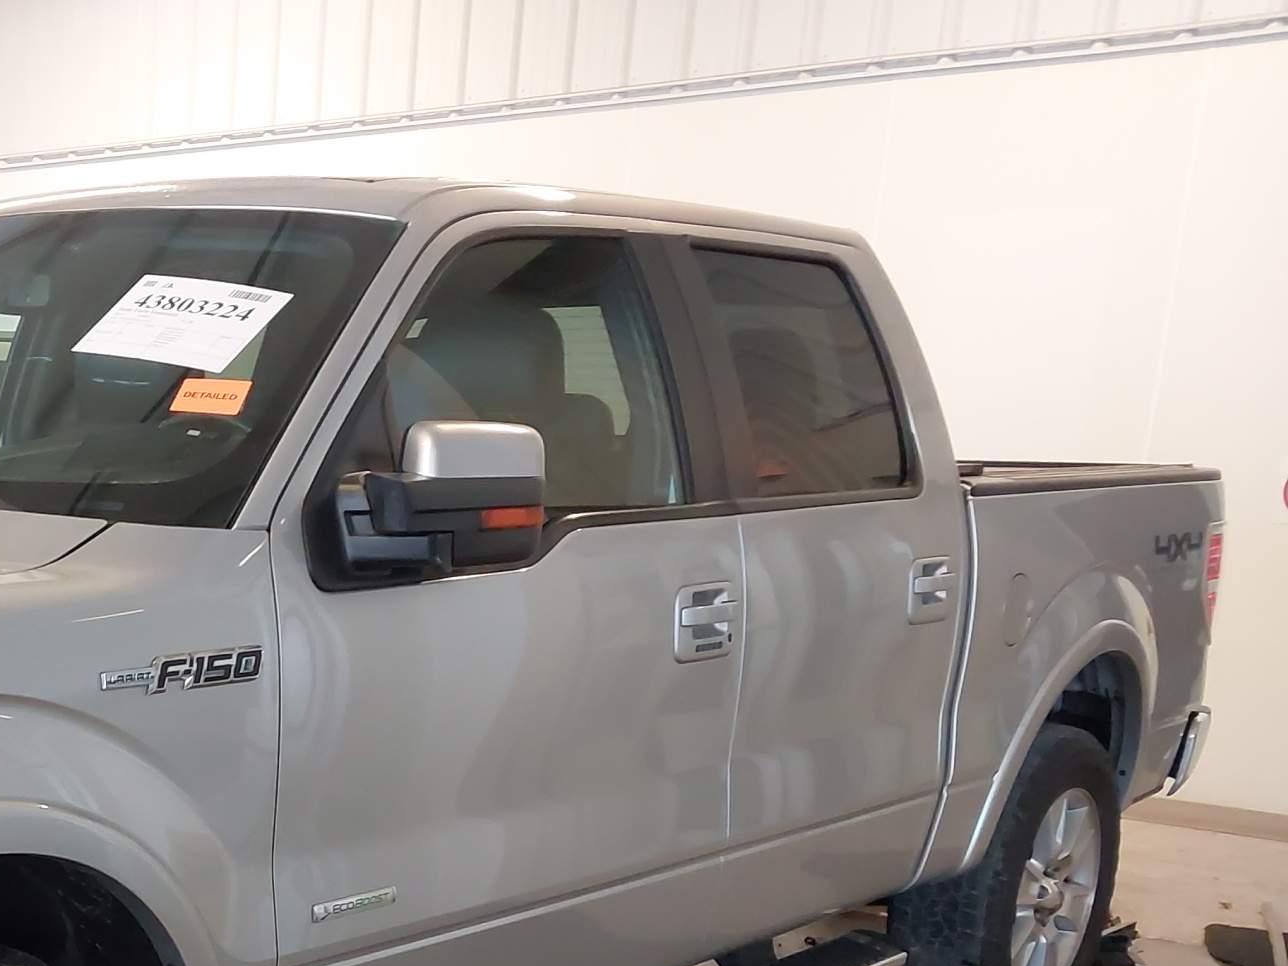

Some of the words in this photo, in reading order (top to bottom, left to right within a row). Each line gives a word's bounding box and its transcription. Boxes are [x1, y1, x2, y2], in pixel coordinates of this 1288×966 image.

[134, 293, 256, 323] 43803224
[182, 390, 239, 401] DETAILED
[156, 648, 263, 690] F-150
